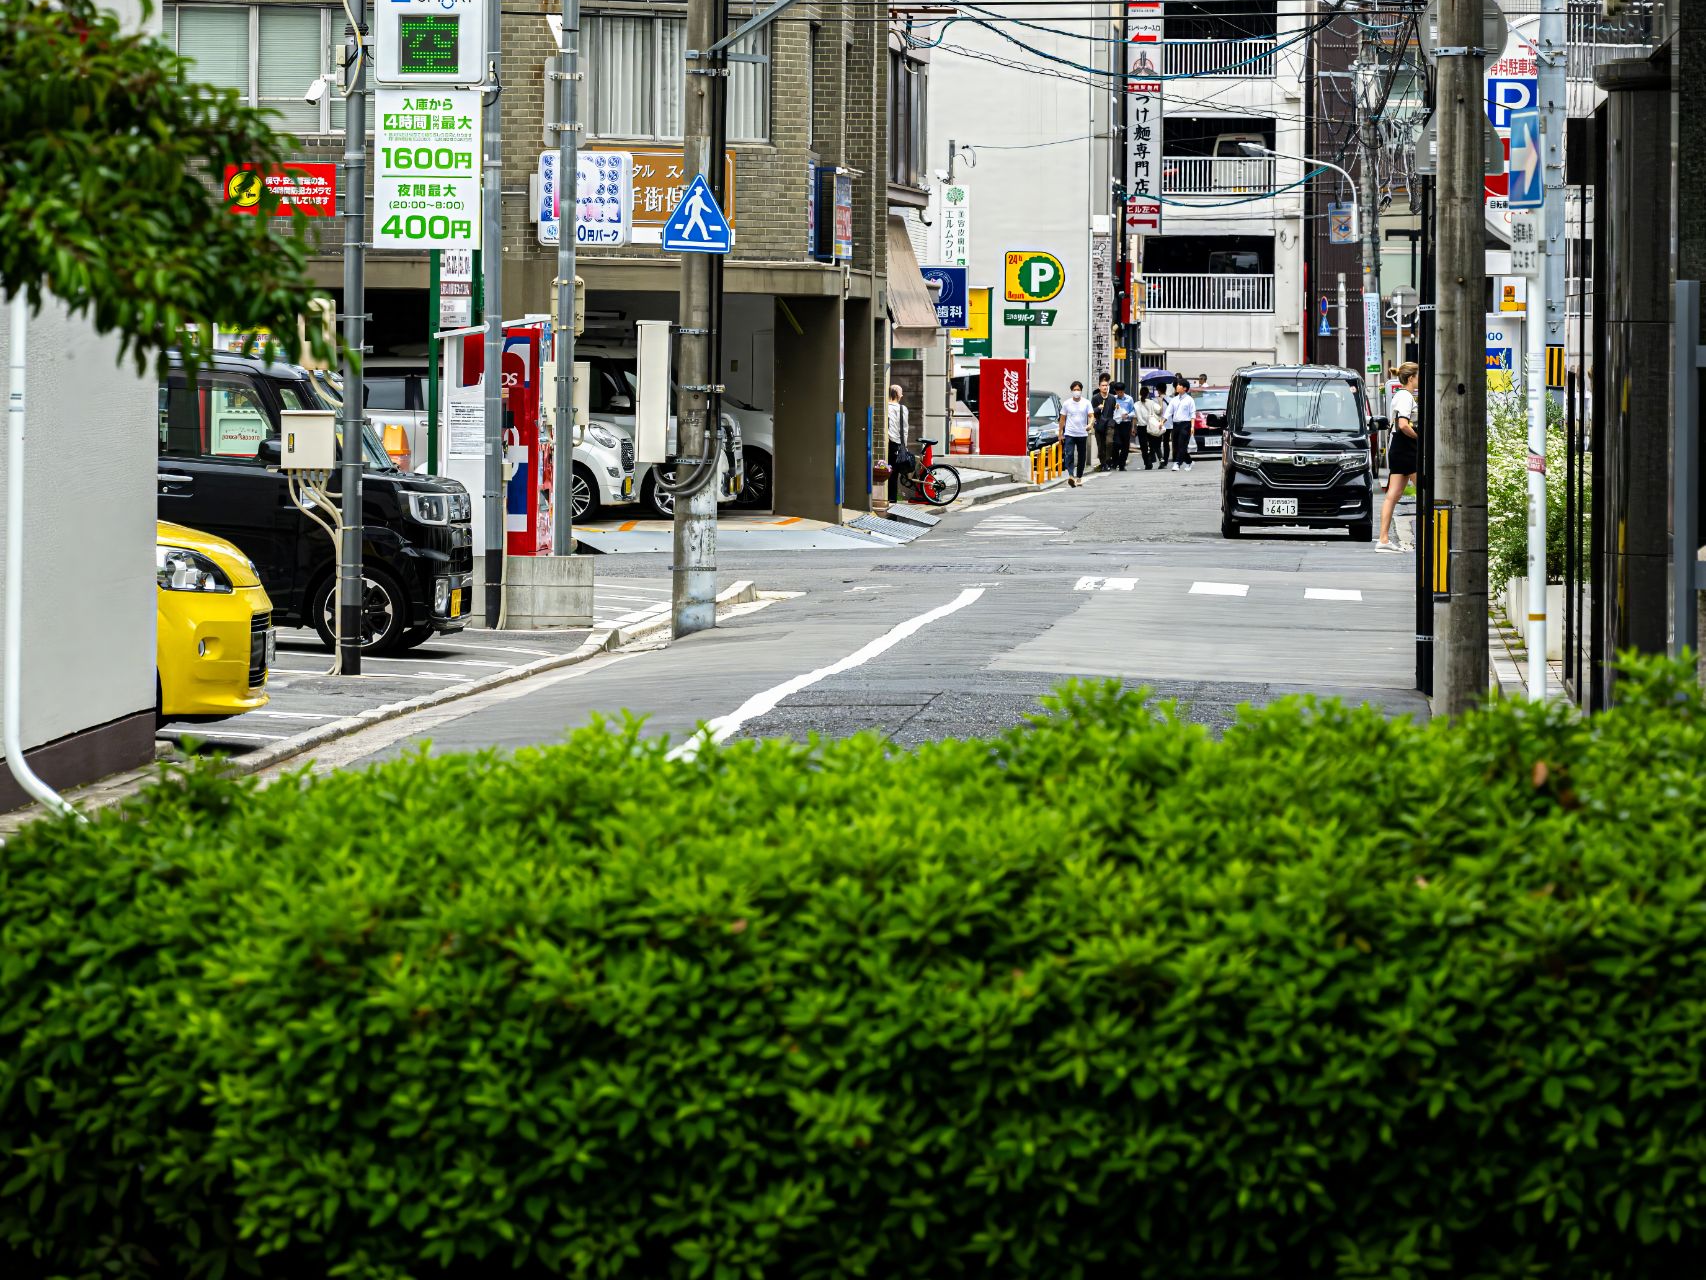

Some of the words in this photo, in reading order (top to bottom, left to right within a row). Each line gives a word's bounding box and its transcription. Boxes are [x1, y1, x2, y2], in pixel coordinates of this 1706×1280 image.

[402, 16, 459, 73] 空
[402, 98, 453, 111] 入庫から
[1495, 81, 1531, 126] P
[381, 147, 472, 169] 1600円
[397, 184, 457, 198] 夜間最大
[380, 214, 472, 240] 400円
[1031, 262, 1055, 293] P
